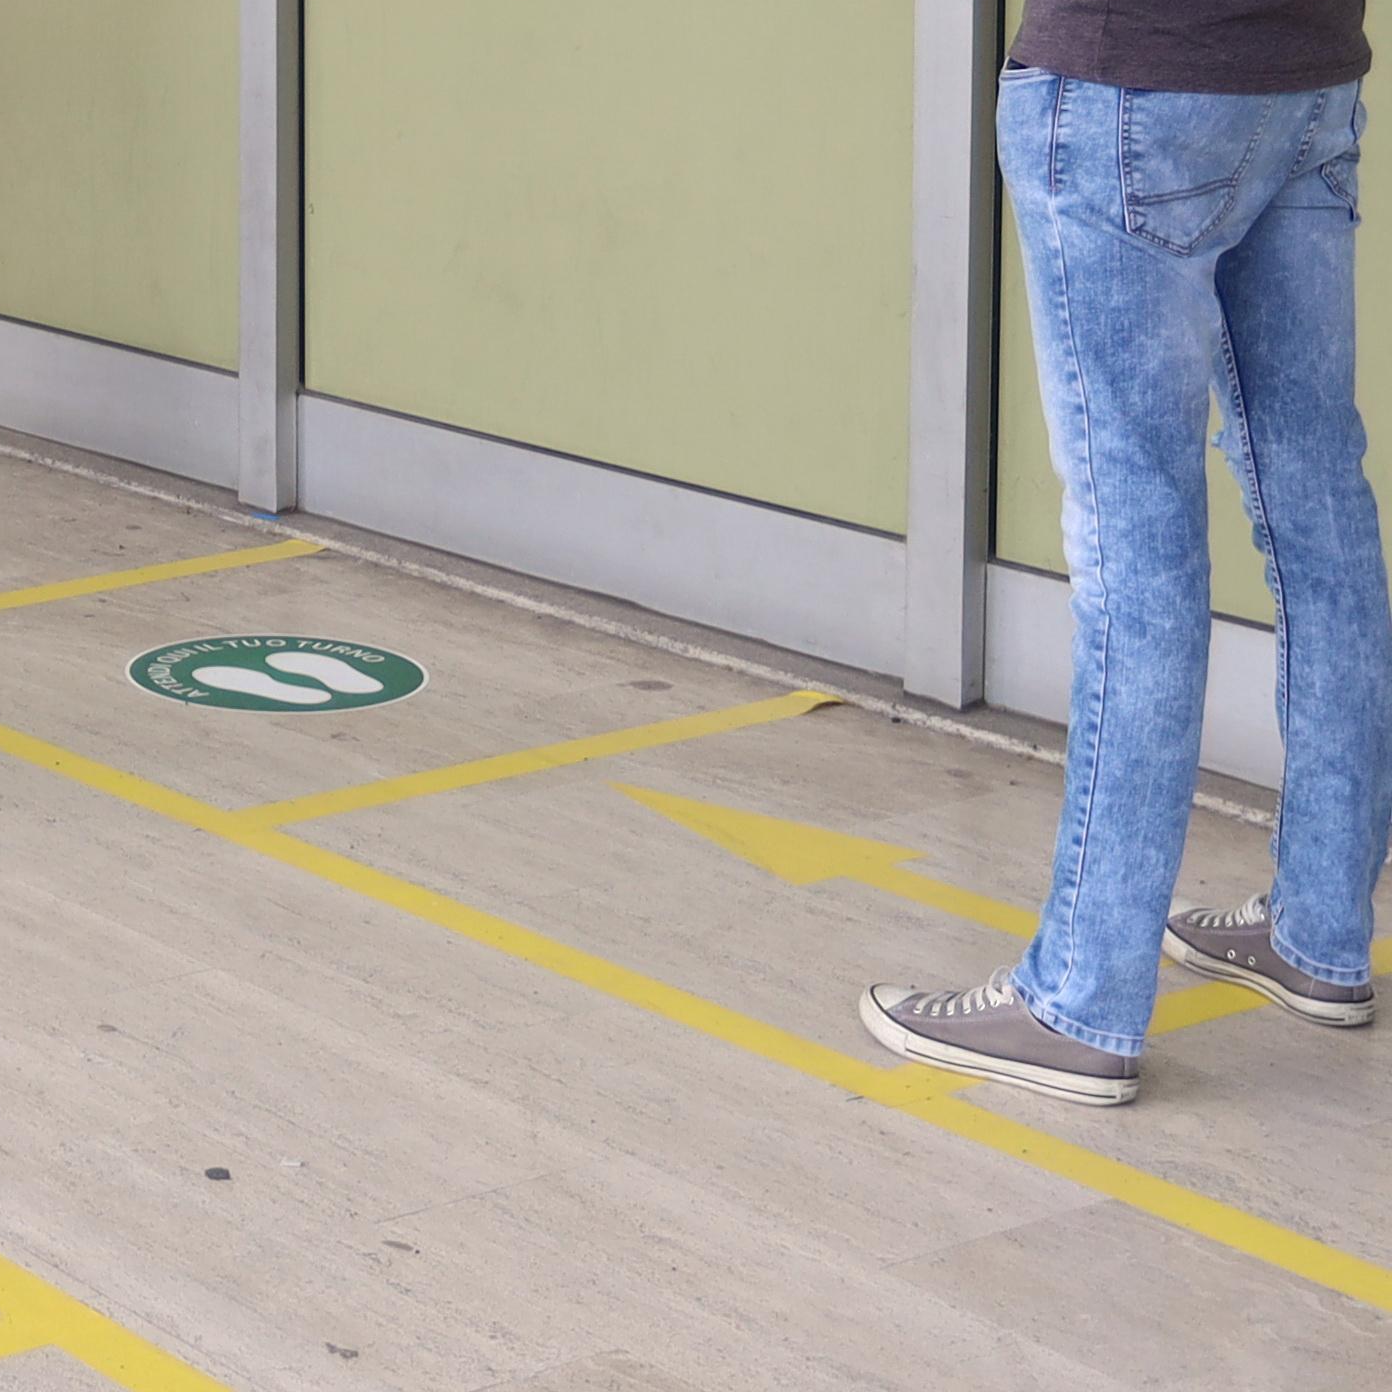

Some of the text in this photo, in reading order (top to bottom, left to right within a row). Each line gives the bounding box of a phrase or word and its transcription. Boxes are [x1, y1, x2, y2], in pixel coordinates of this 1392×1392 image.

[148, 639, 386, 698] ATTENDI QUI IL TUO TURNO
